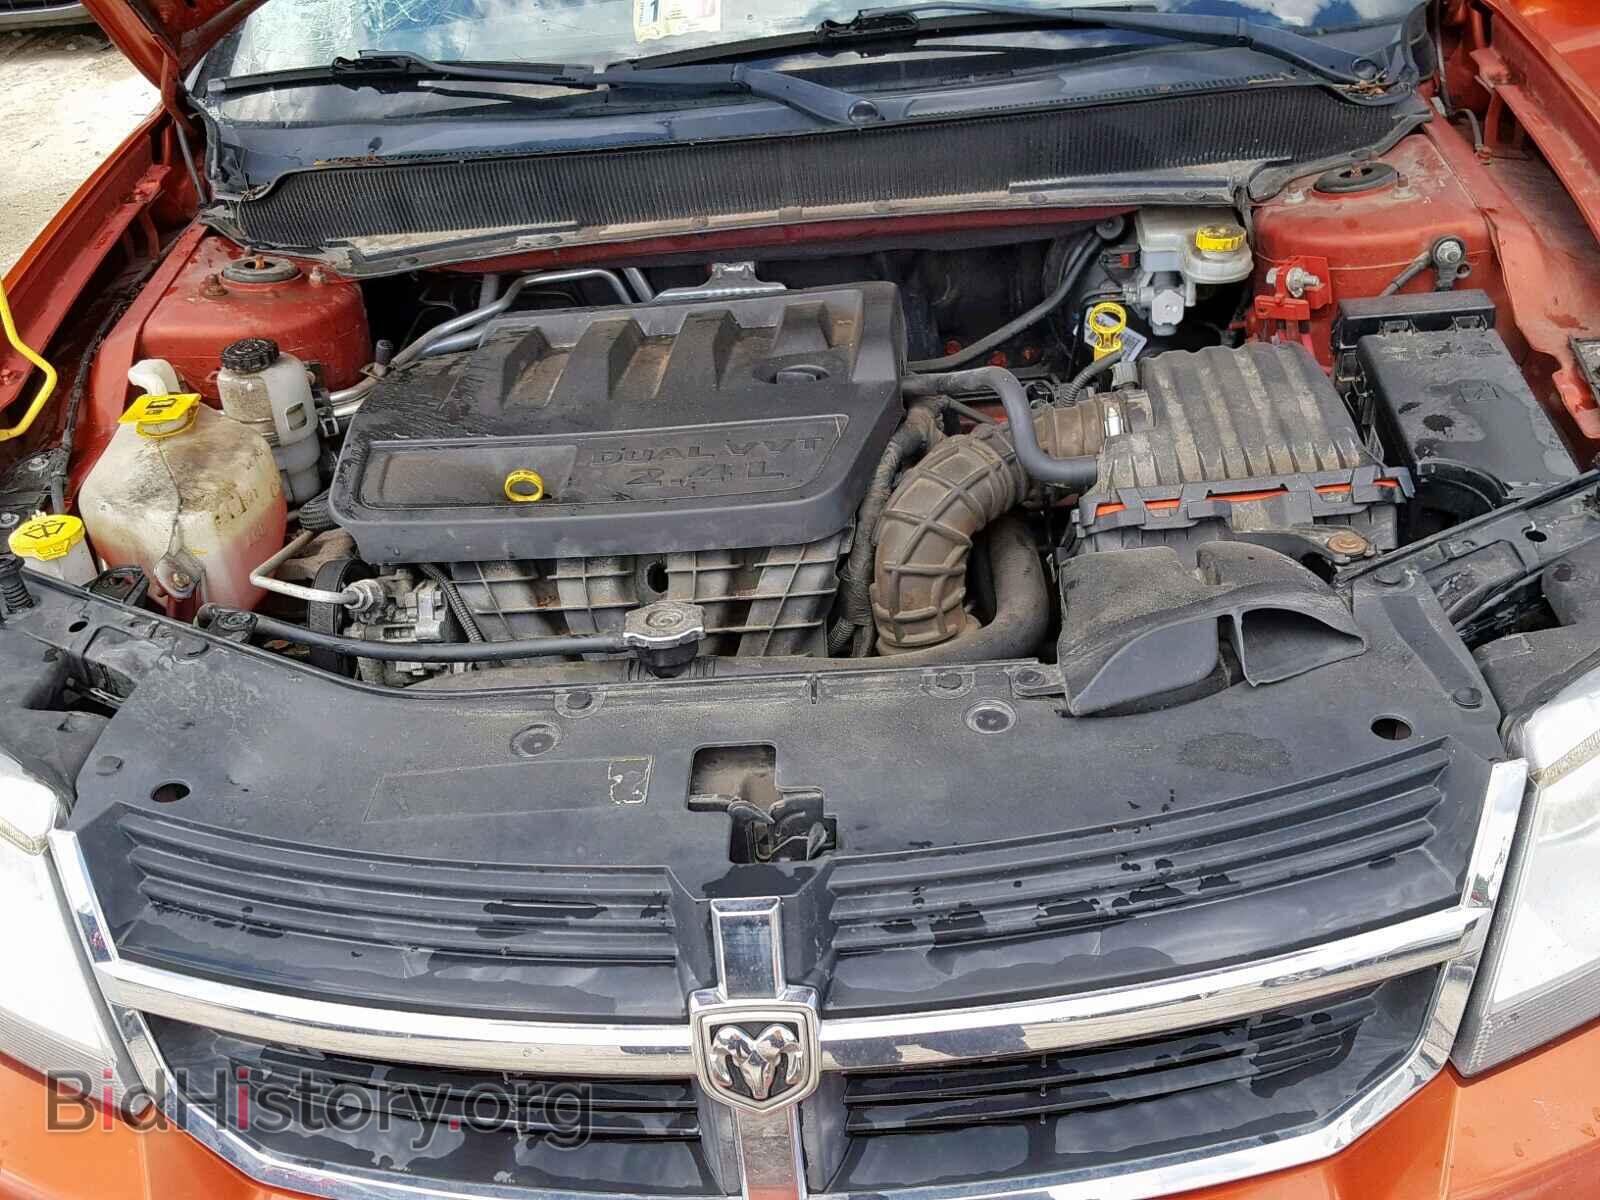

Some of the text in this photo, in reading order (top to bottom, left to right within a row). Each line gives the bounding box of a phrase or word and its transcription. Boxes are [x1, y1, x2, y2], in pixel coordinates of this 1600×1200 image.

[591, 437, 825, 466] DUAL VVT
[625, 460, 786, 488] 2.4L
